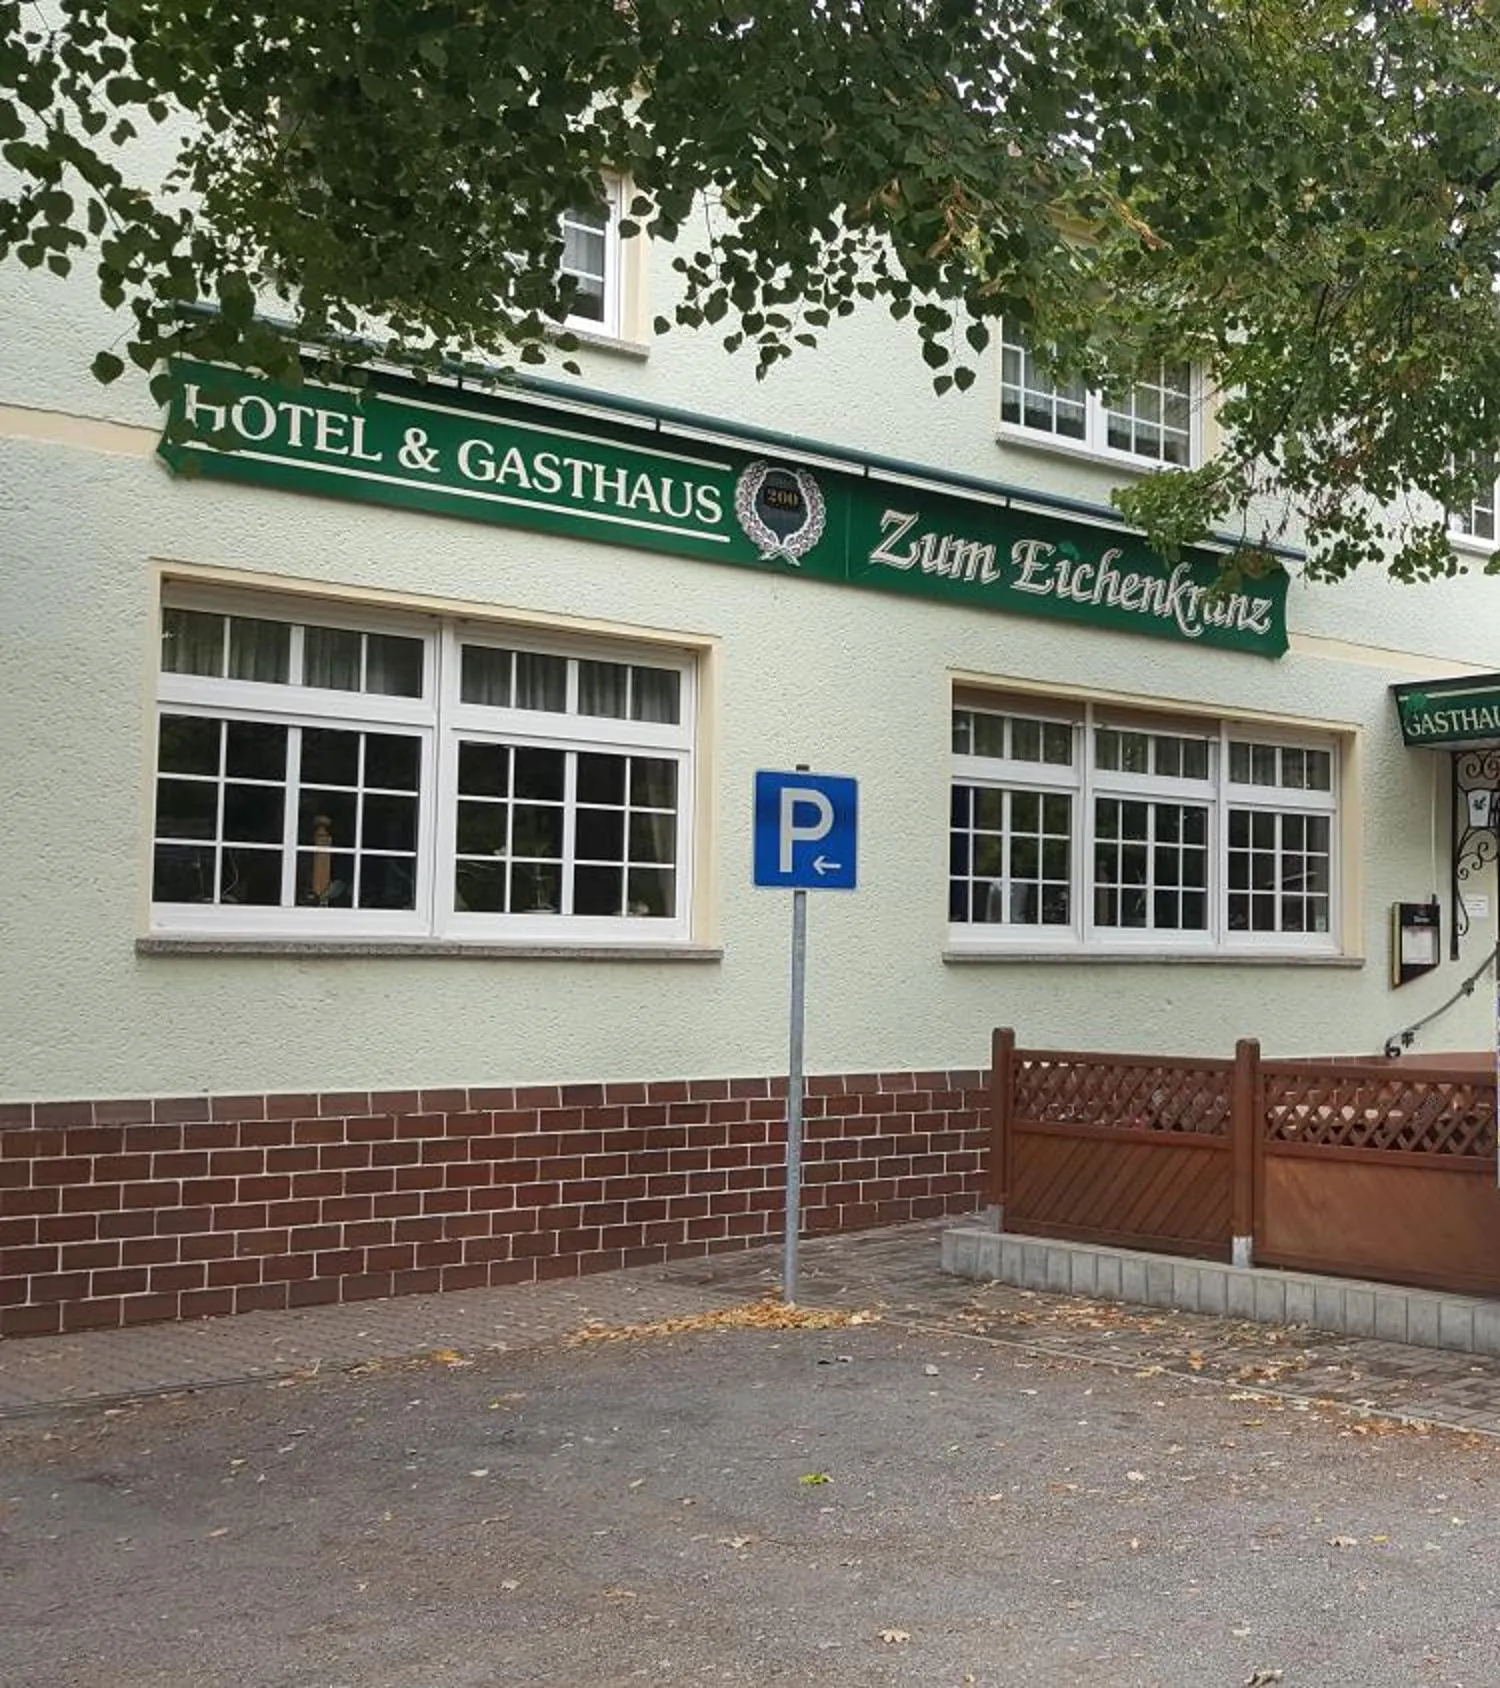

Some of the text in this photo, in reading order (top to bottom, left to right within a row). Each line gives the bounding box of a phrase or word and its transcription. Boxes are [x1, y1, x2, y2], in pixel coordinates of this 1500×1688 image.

[183, 383, 724, 524] HOTEL & GASTHAUS
[868, 508, 1273, 637] Zum Eichenkranz
[779, 787, 835, 873] P
